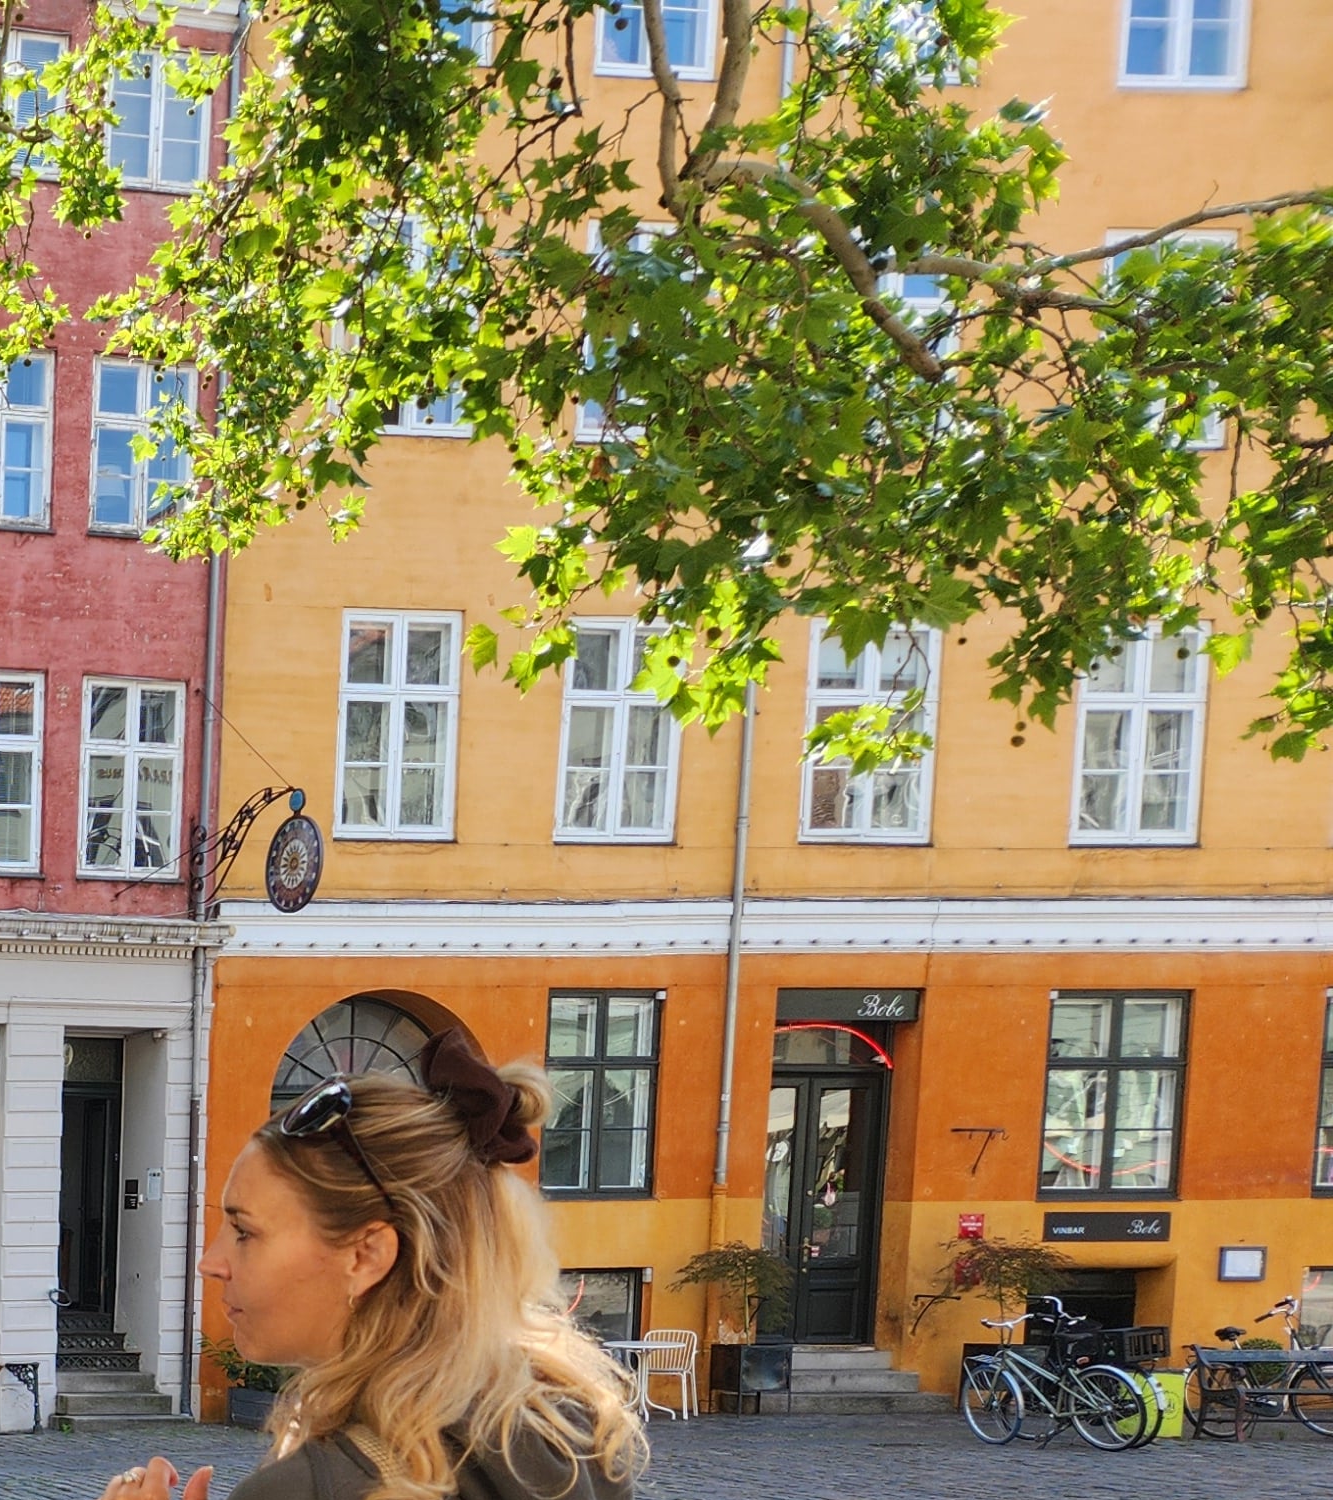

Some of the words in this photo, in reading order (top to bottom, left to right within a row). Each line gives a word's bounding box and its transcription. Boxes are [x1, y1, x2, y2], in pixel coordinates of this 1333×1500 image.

[857, 994, 905, 1017] Bobe
[1052, 1226, 1085, 1235] VINBAR
[1127, 1219, 1162, 1235] Bobe
